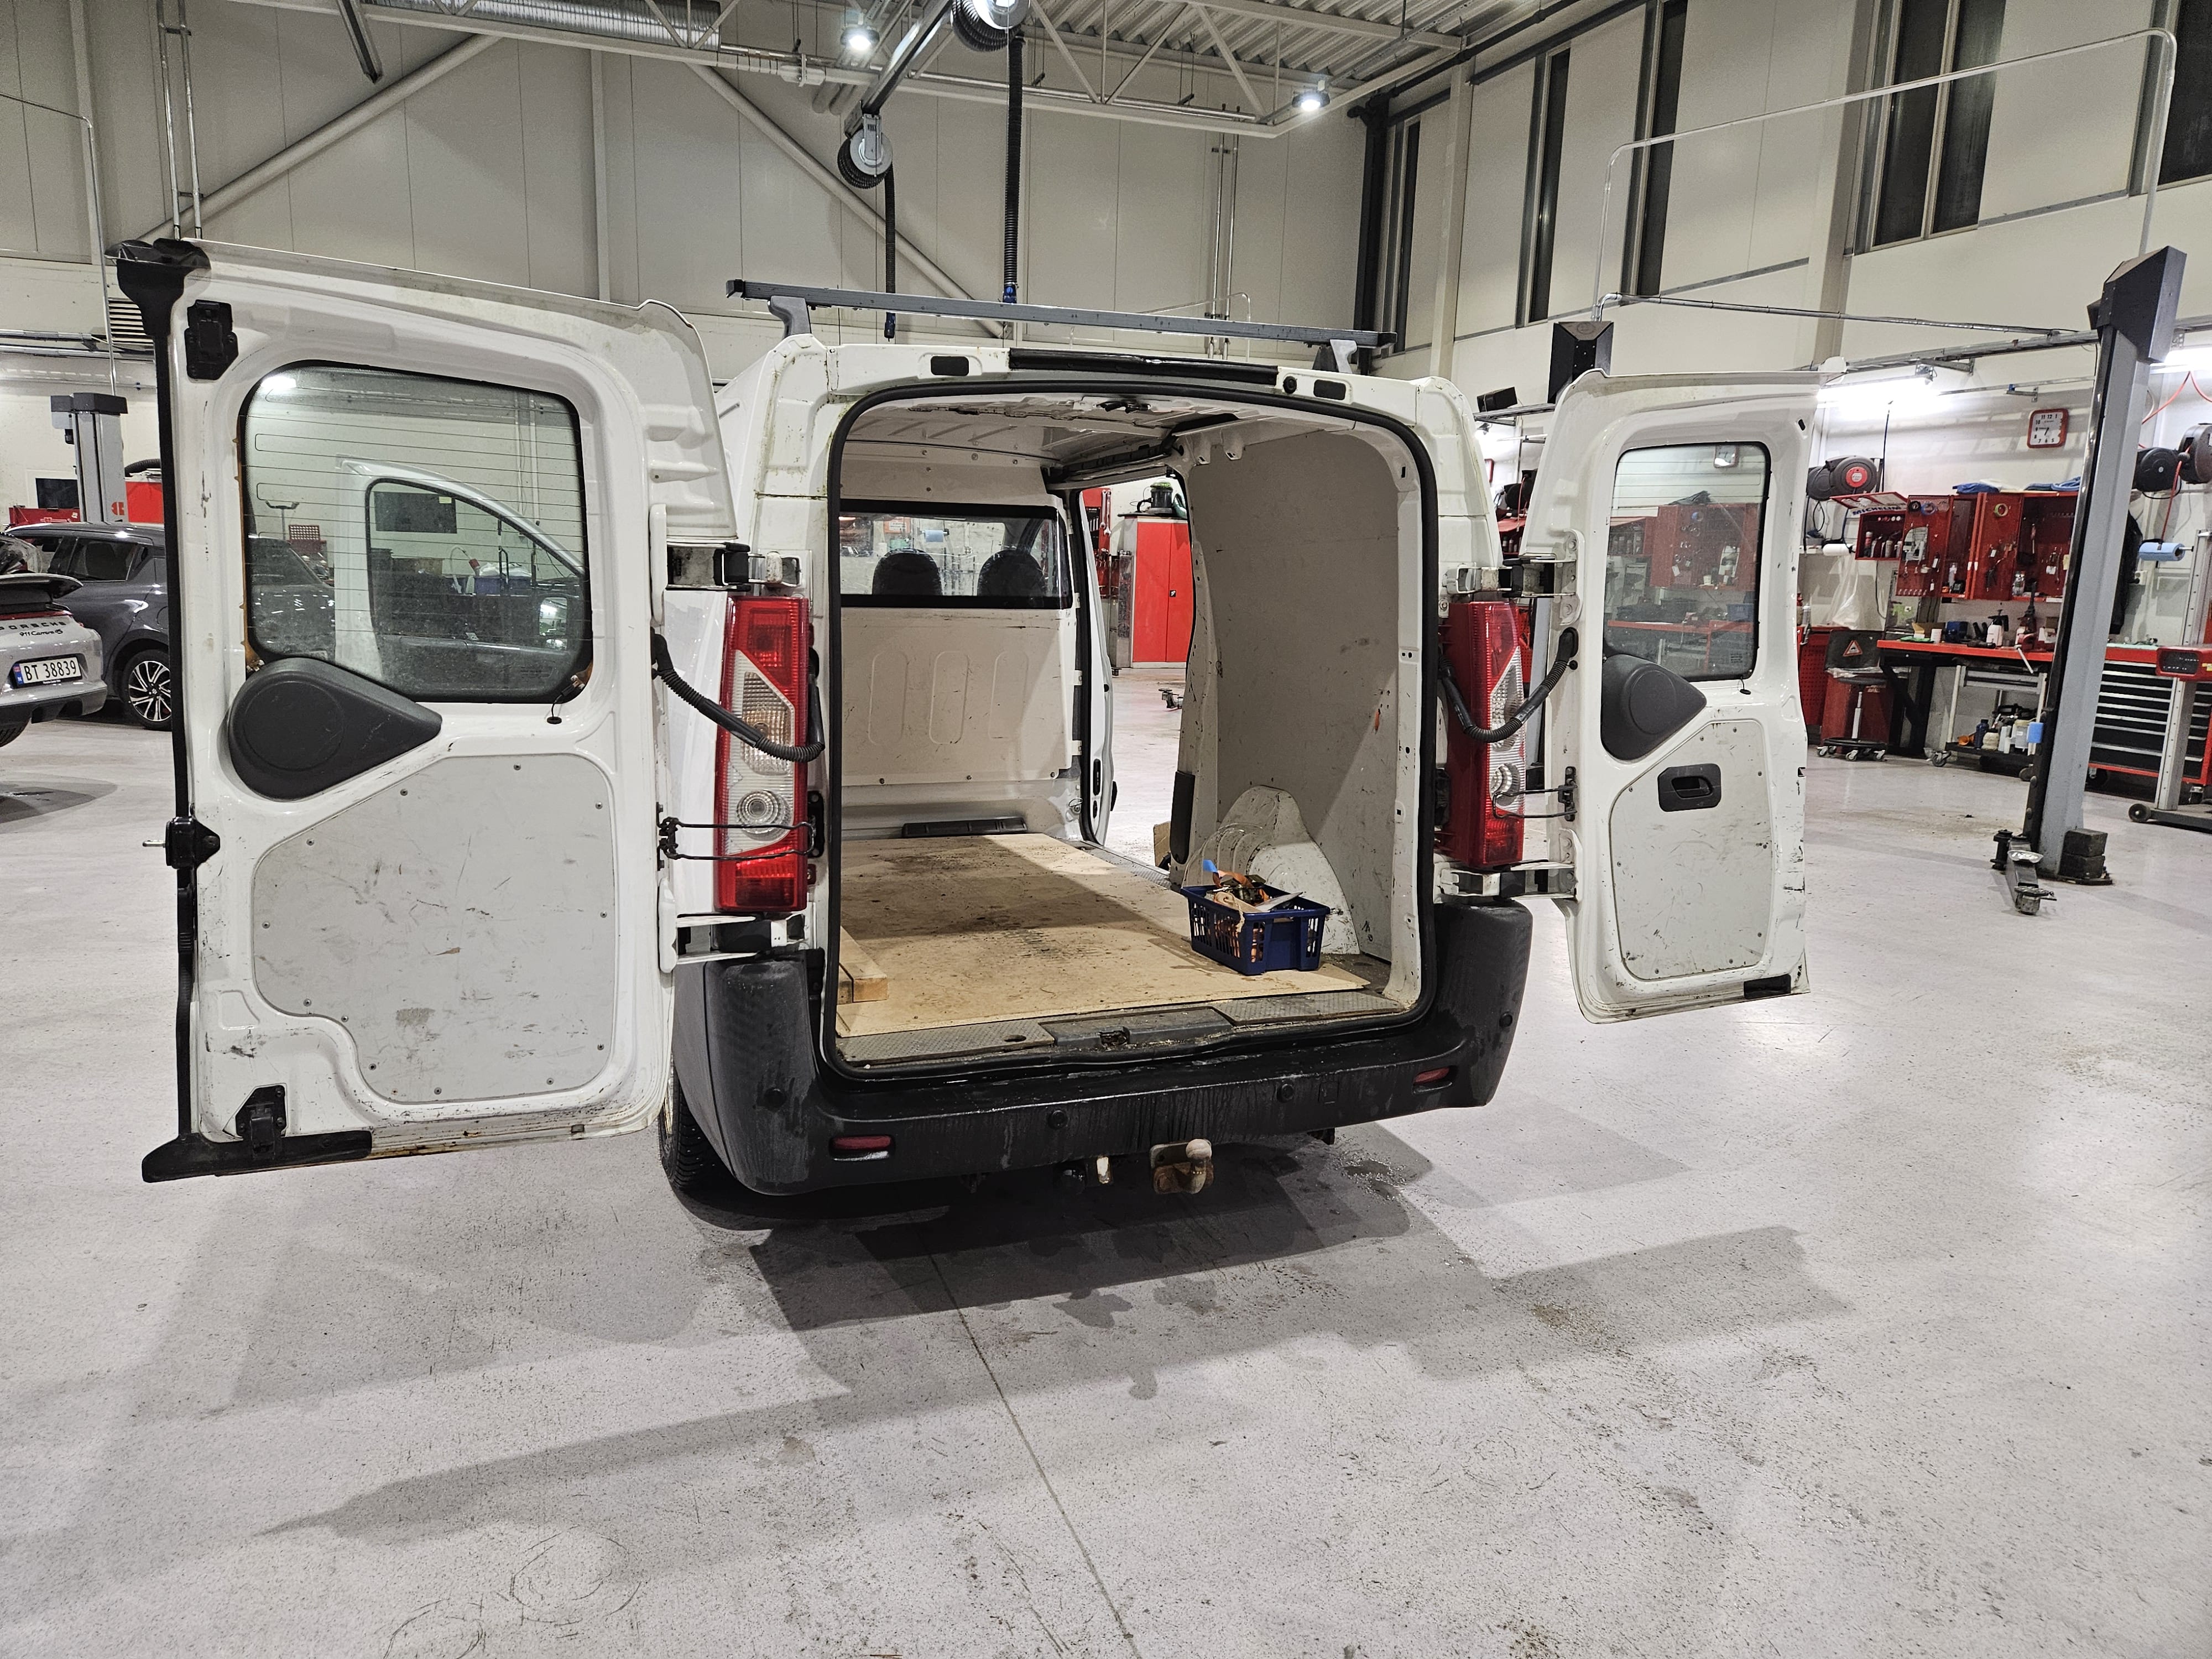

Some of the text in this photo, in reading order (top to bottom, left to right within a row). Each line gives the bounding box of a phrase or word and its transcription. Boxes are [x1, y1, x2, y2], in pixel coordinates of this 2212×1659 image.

[1853, 506, 1901, 515] MICHELIN
[24, 660, 76, 681] BT 38839
